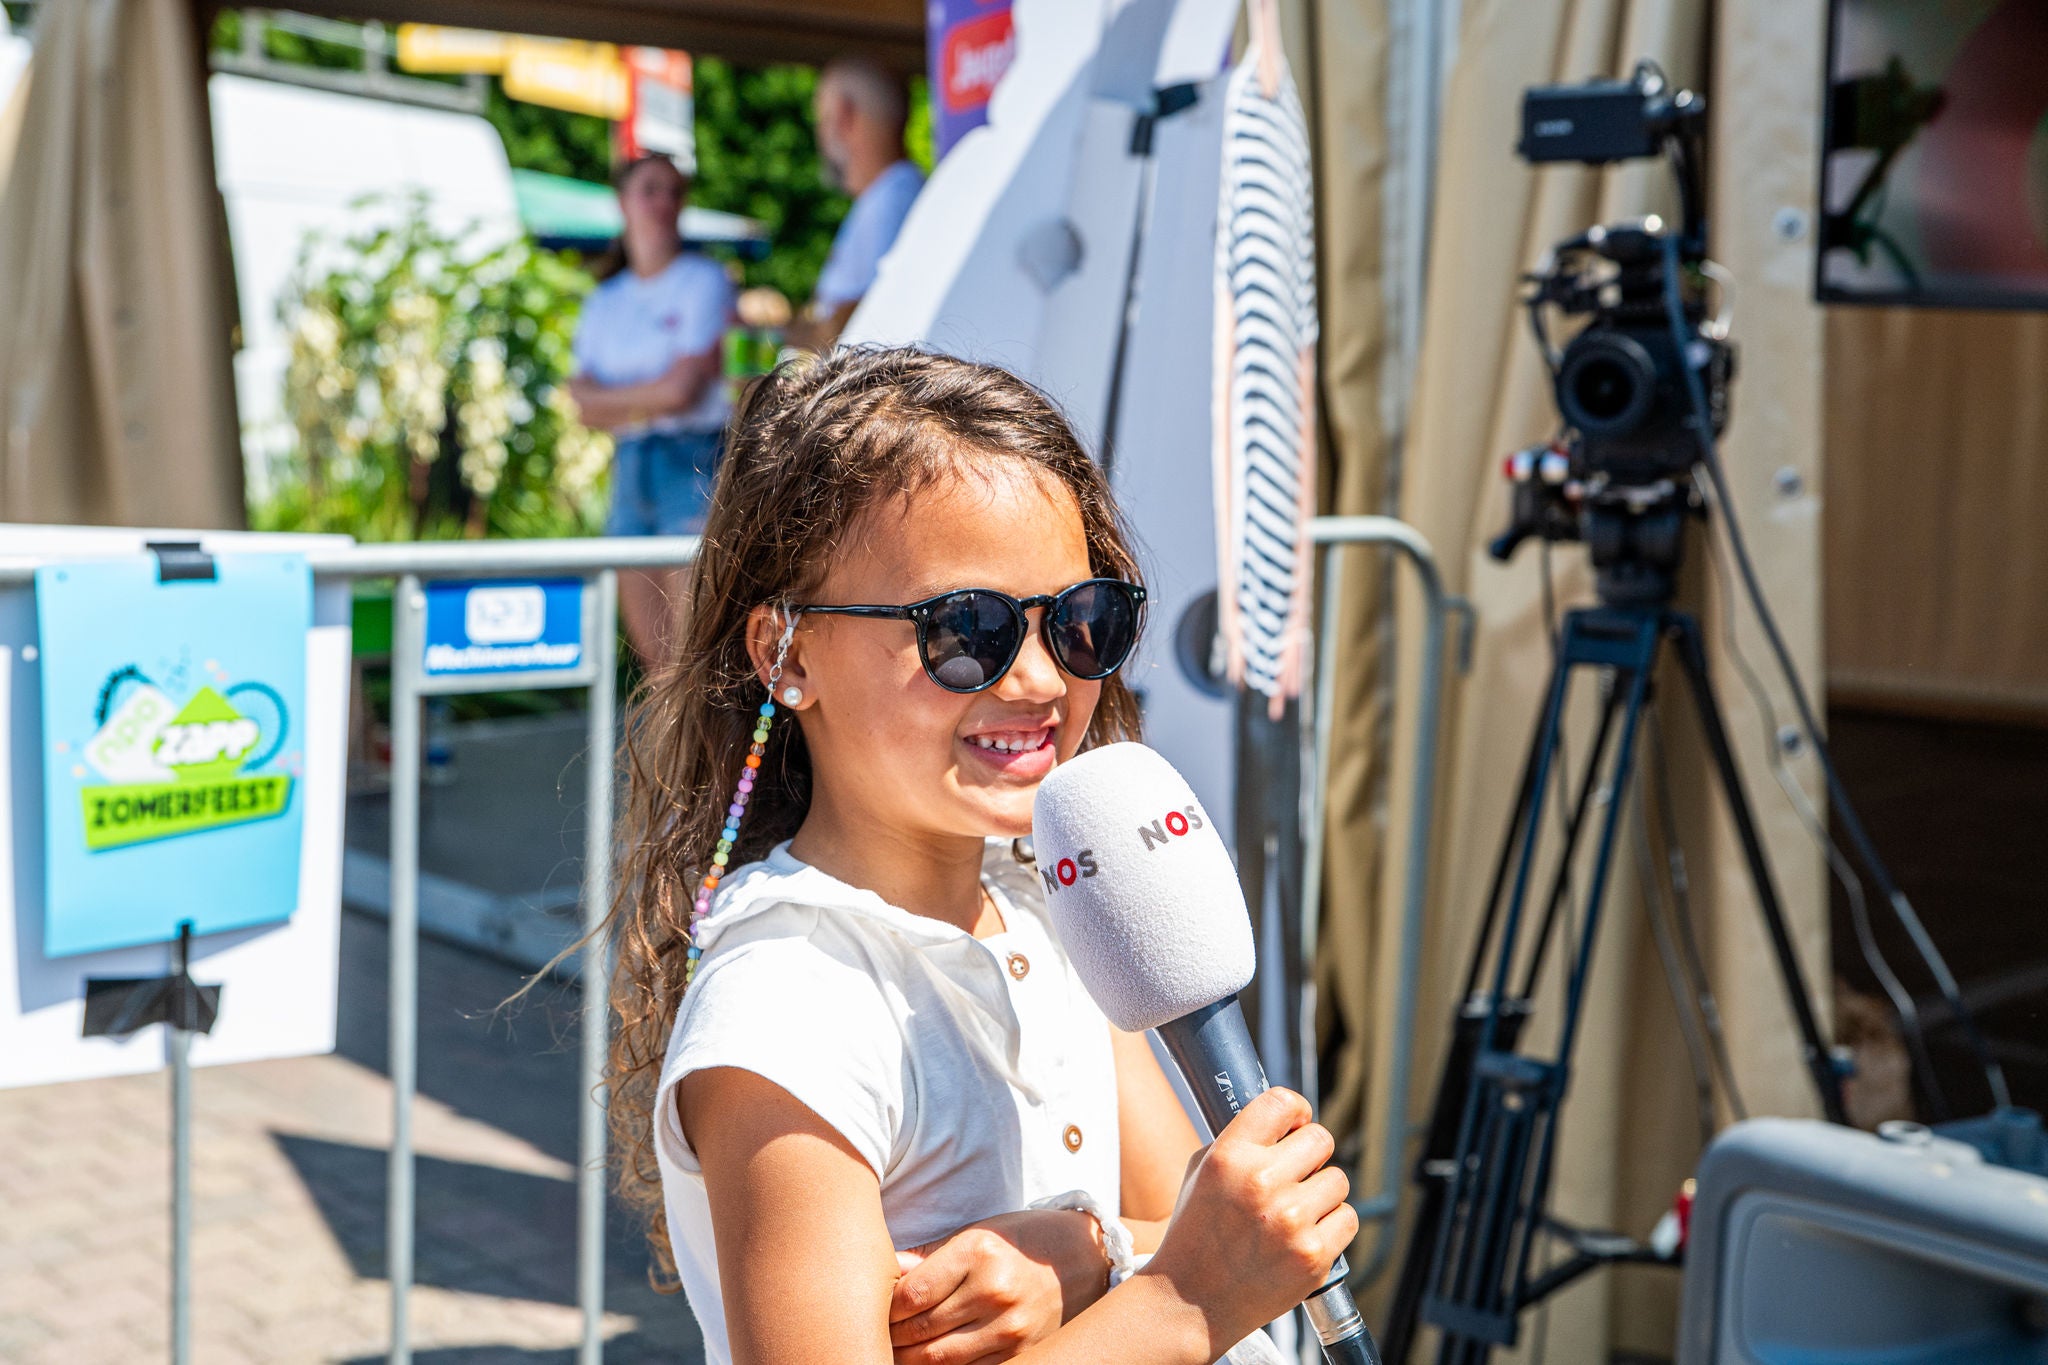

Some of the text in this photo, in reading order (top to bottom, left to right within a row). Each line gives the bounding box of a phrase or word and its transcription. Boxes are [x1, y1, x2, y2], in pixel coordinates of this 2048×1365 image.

[92, 780, 277, 829] ZOMERFEEST
[1138, 805, 1203, 851] NOS
[1041, 850, 1099, 894] NOS
